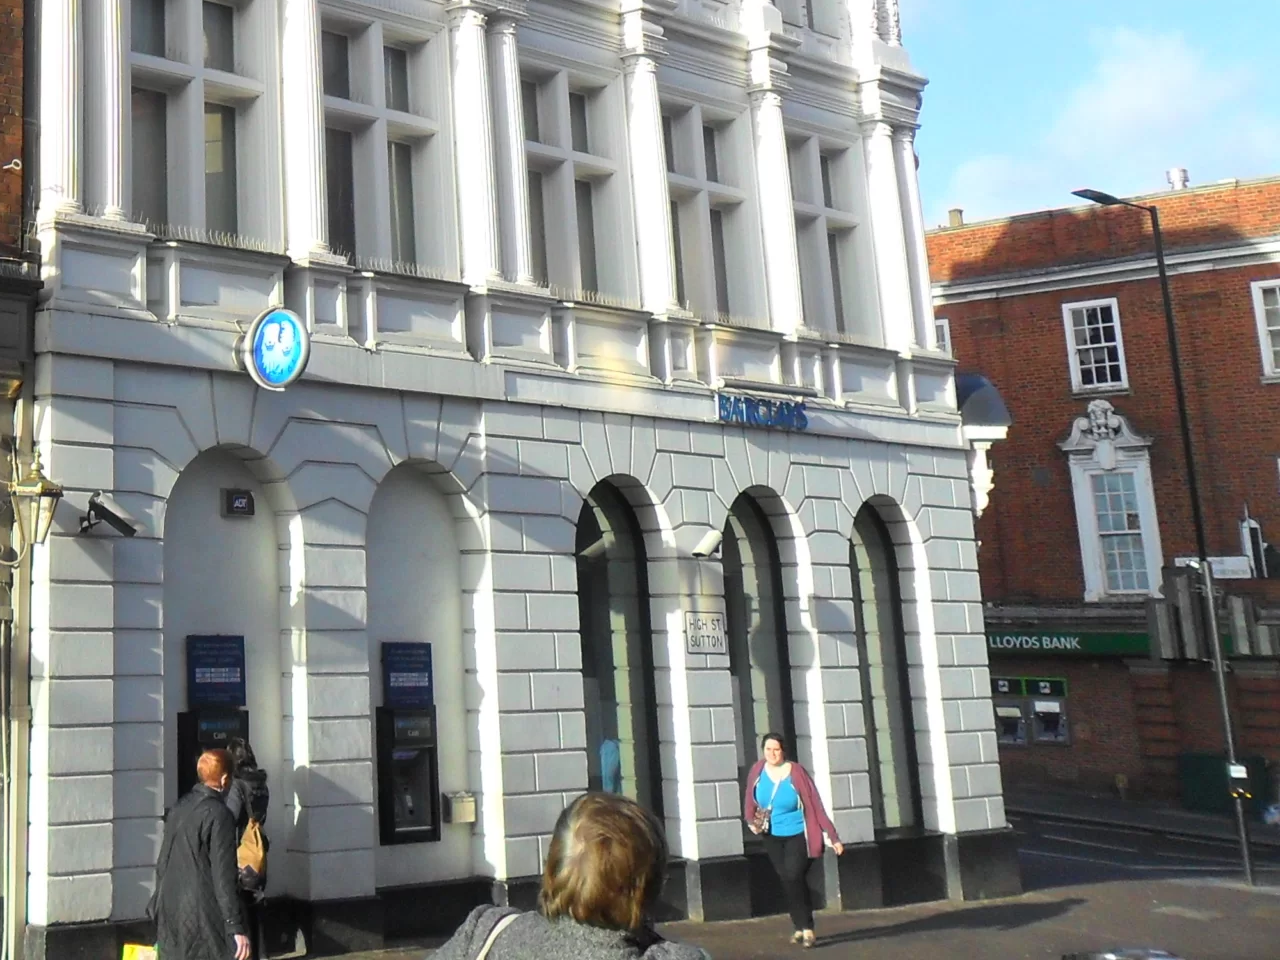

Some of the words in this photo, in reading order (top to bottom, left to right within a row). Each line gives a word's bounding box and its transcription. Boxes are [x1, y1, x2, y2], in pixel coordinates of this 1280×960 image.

[716, 393, 808, 430] BARCLAYS
[689, 618, 707, 631] HIGH
[690, 635, 722, 648] SUTTON
[989, 635, 1040, 648] LLOYDS
[1042, 636, 1081, 649] BANK
